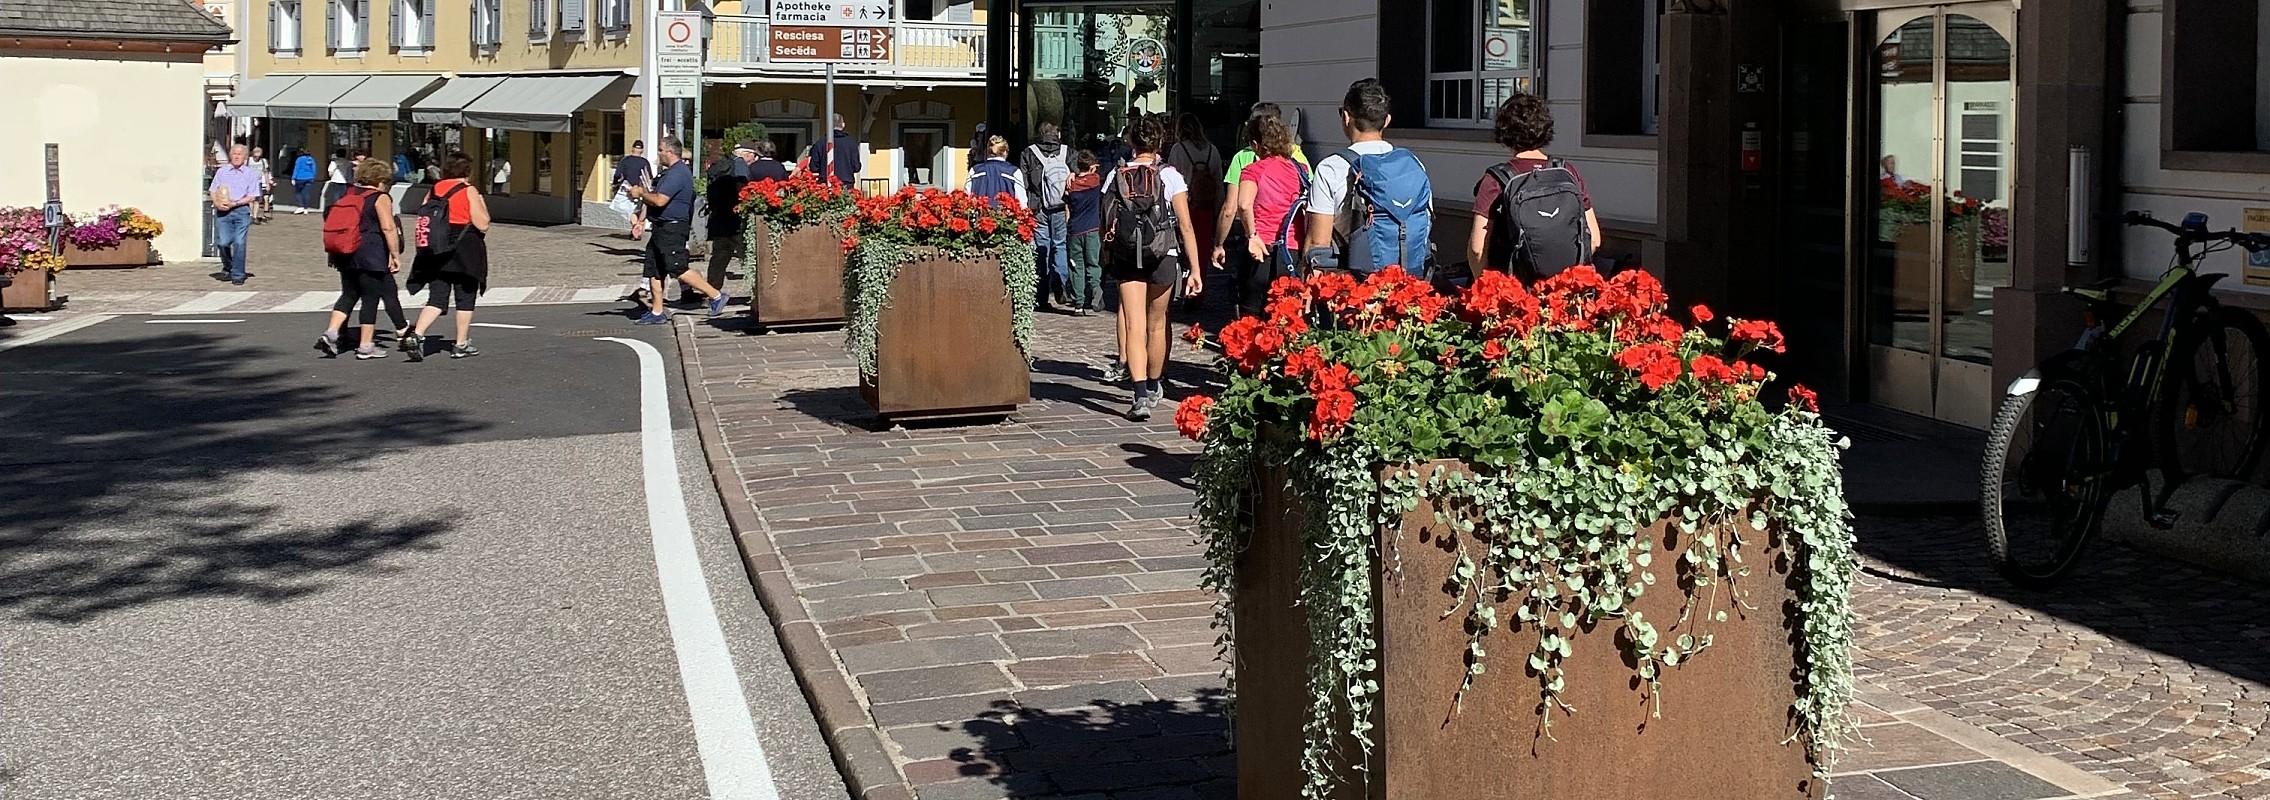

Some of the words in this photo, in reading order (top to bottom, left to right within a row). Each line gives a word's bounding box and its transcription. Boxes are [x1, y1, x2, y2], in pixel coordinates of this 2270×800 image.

[776, 1, 831, 12] Apotheke
[775, 11, 826, 21] farmacia
[774, 30, 824, 41] Resciesa
[775, 45, 817, 56] Secëda
